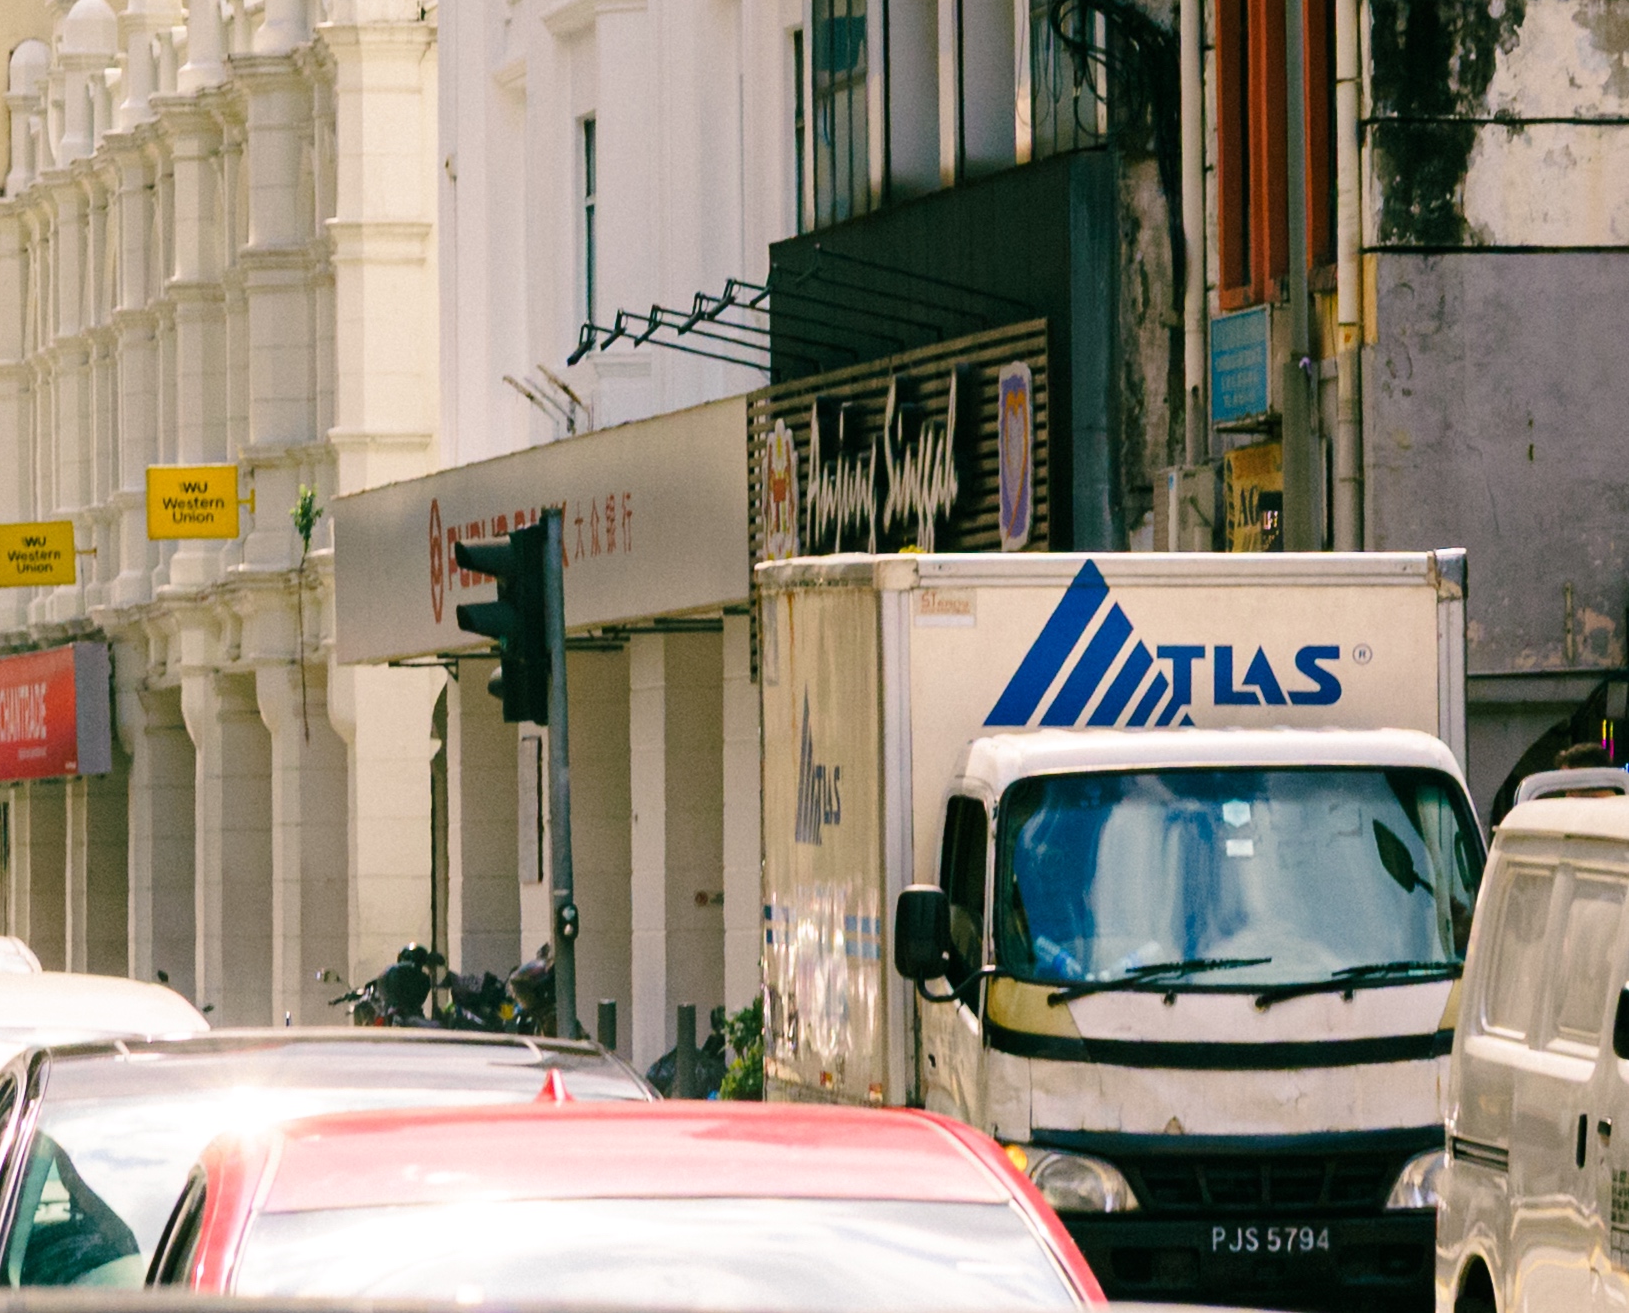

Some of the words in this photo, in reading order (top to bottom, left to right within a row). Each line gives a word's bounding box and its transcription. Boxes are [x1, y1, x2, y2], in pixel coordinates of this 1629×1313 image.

[162, 497, 225, 510] Western
[172, 511, 214, 524] Union
[7, 550, 62, 562] Western
[16, 562, 54, 574] Union
[1212, 1226, 1259, 1252] PJS
[1267, 1225, 1329, 1252] 5794
